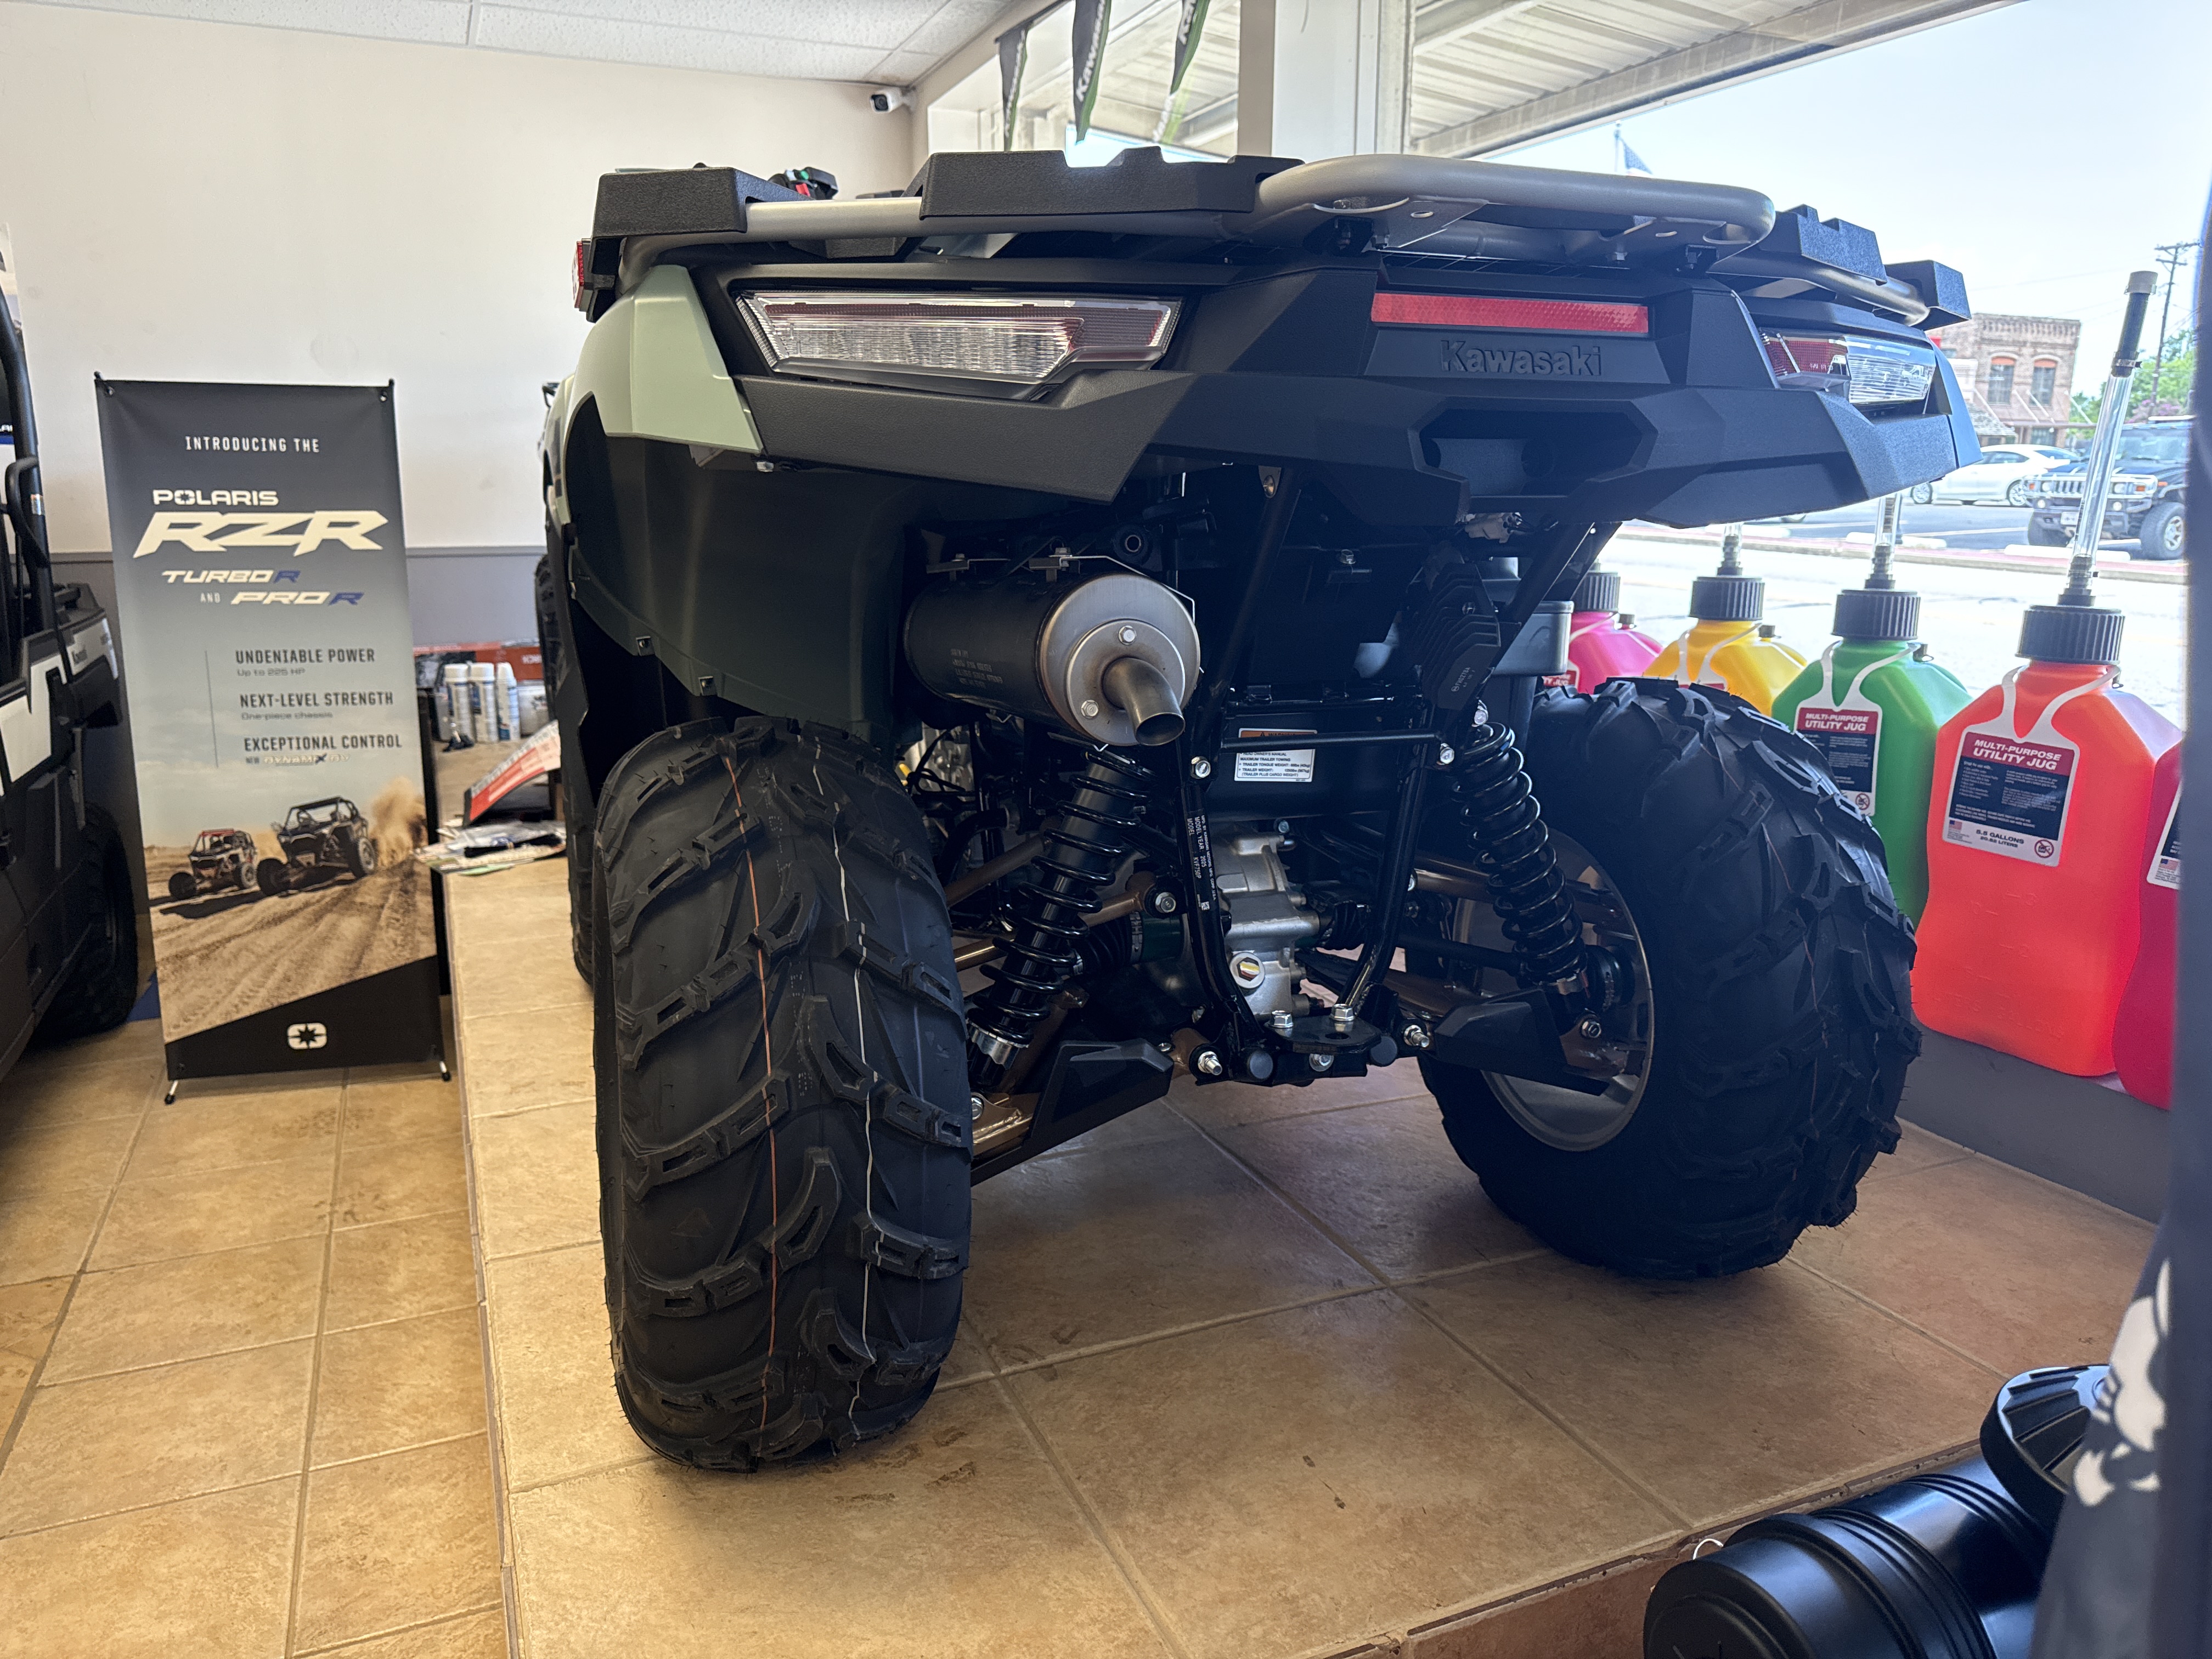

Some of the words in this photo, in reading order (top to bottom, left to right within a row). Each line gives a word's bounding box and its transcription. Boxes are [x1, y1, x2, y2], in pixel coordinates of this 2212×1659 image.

[1440, 340, 1601, 376] Kawasaki
[185, 436, 287, 453] INTRODUCING
[294, 438, 320, 453] THE
[153, 489, 279, 506] POLARIS
[133, 510, 388, 559] RZR
[200, 592, 221, 603] AND
[235, 648, 323, 664] UNDENIABLE
[328, 648, 375, 663] POWER
[240, 693, 319, 708] NEXT-LEVEL
[324, 691, 393, 706] STRENGTH
[1805, 713, 1869, 723] MULTI-PURPOSE
[1805, 720, 1842, 730] UTILITY
[1843, 723, 1866, 731] JUG
[244, 735, 337, 752] EXCEPTIONAL
[342, 734, 402, 749] CONTROL
[1974, 740, 2062, 761] MULTI-PURPOSE
[1973, 748, 2025, 764] UTILITY
[2027, 758, 2057, 770] JUG
[1990, 832, 2024, 844] GALLONS
[1187, 818, 1195, 836] MODEL
[1193, 857, 1201, 879] KVF750P
